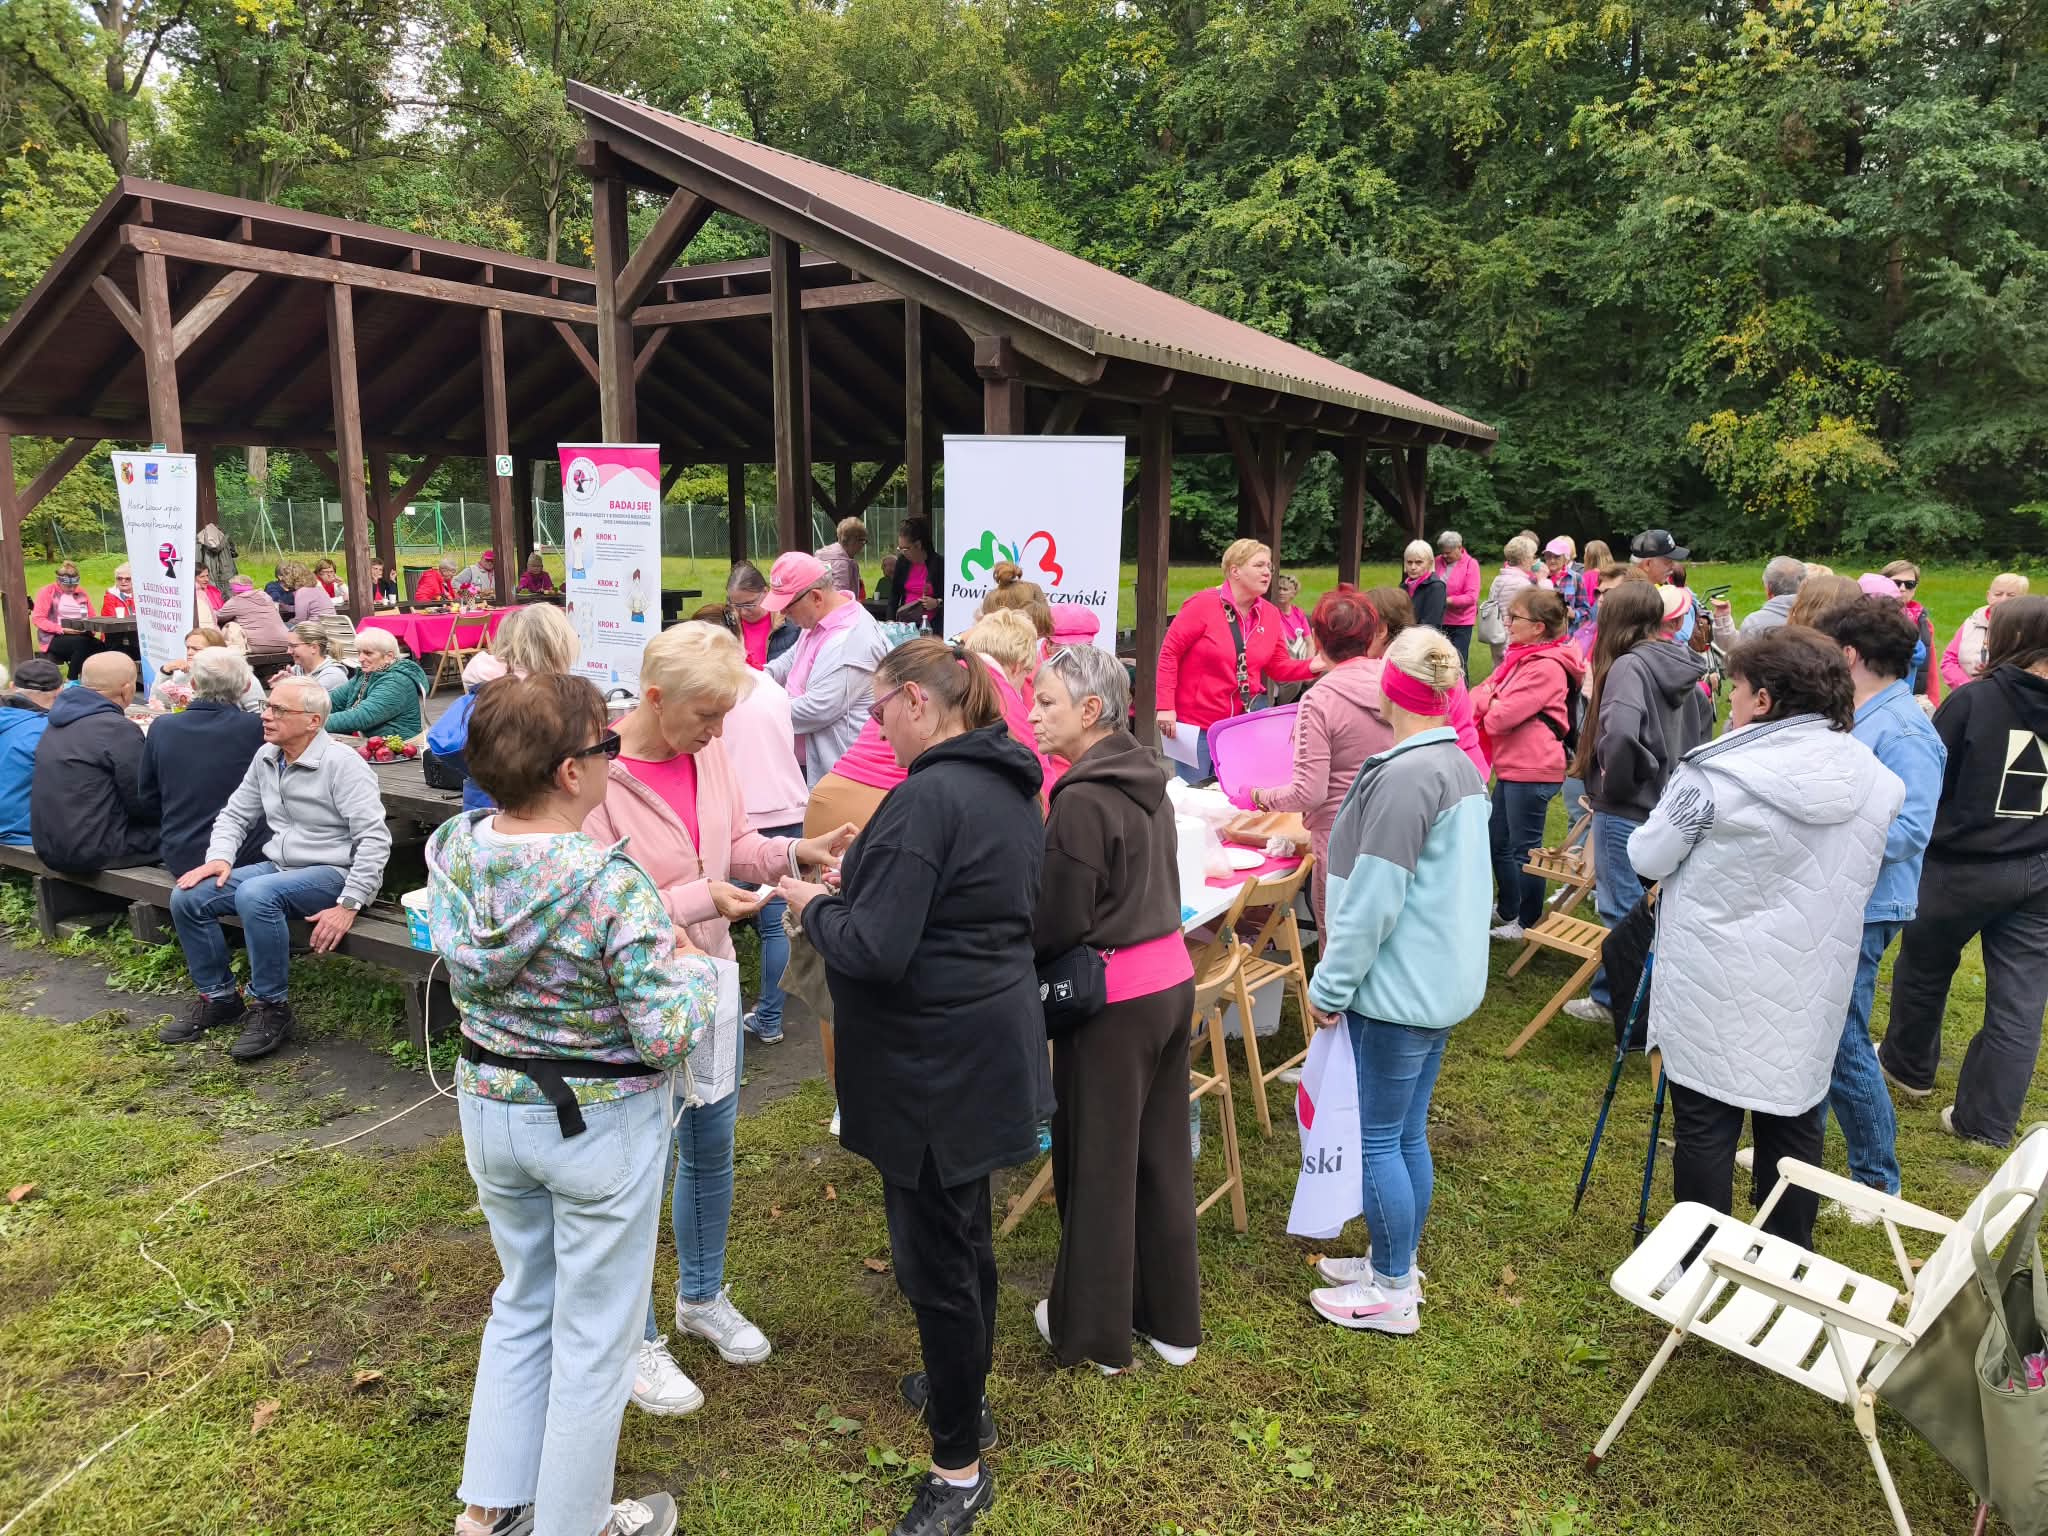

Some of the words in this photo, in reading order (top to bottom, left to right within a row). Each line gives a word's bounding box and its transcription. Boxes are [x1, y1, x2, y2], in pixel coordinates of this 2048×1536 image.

[609, 500, 636, 511] BADAJ
[637, 501, 652, 513] SIĘ!
[596, 533, 612, 541] KROK
[598, 620, 614, 628] KROK
[587, 661, 603, 669] KROK
[1301, 1146, 1343, 1175] ski
